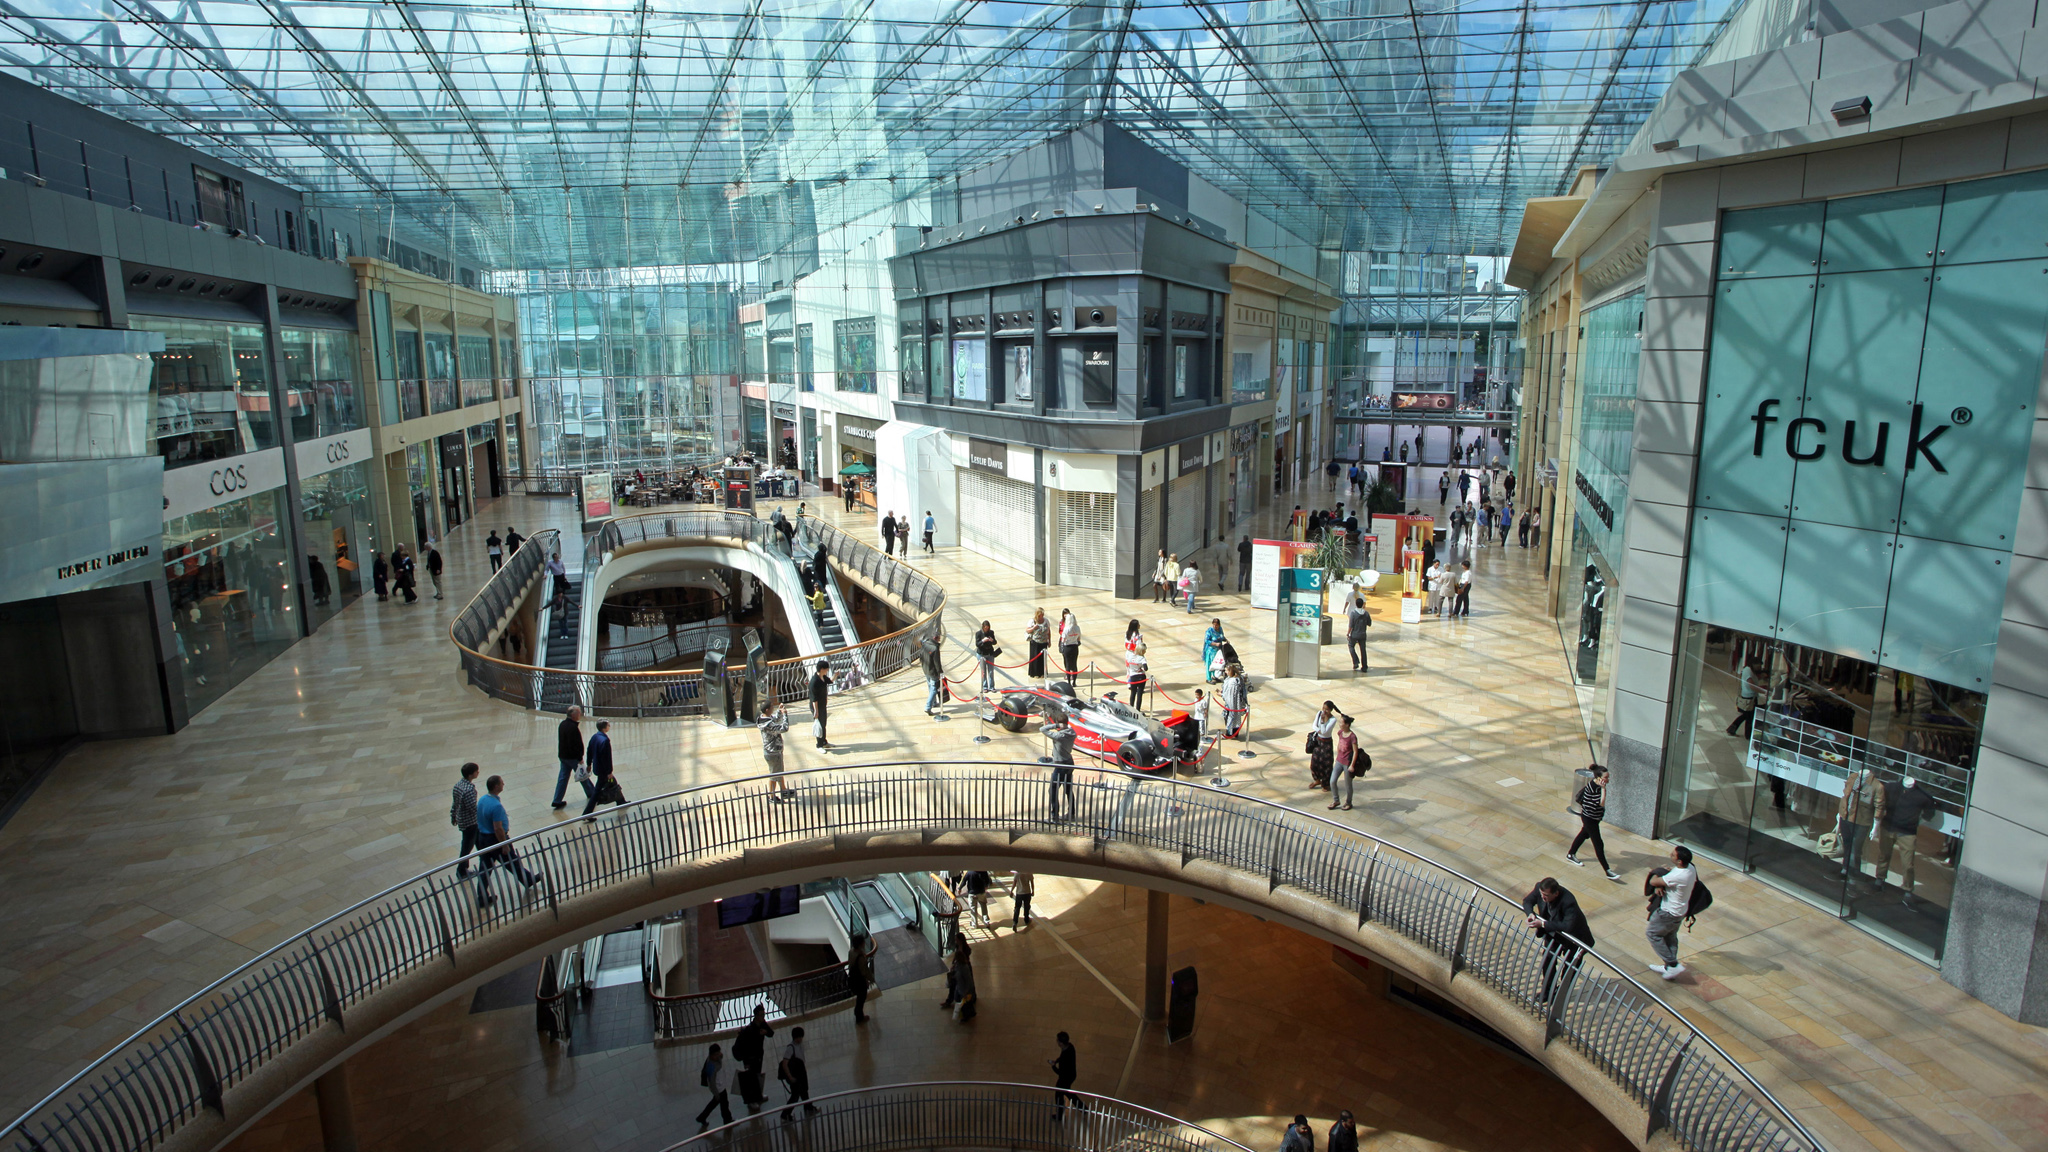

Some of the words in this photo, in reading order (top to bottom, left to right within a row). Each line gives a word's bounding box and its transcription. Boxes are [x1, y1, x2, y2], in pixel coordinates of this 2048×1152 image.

[843, 425, 866, 438] STARBUCKS
[327, 440, 350, 464] COS
[446, 443, 463, 452] LINKS
[970, 453, 987, 466] LESLIE
[987, 457, 1004, 470] DAVIS
[209, 464, 248, 497] COS
[1310, 572, 1321, 588] 3
[1114, 707, 1133, 718] Mobil
[1160, 737, 1169, 748] 4
[1775, 761, 1791, 772] Soon
